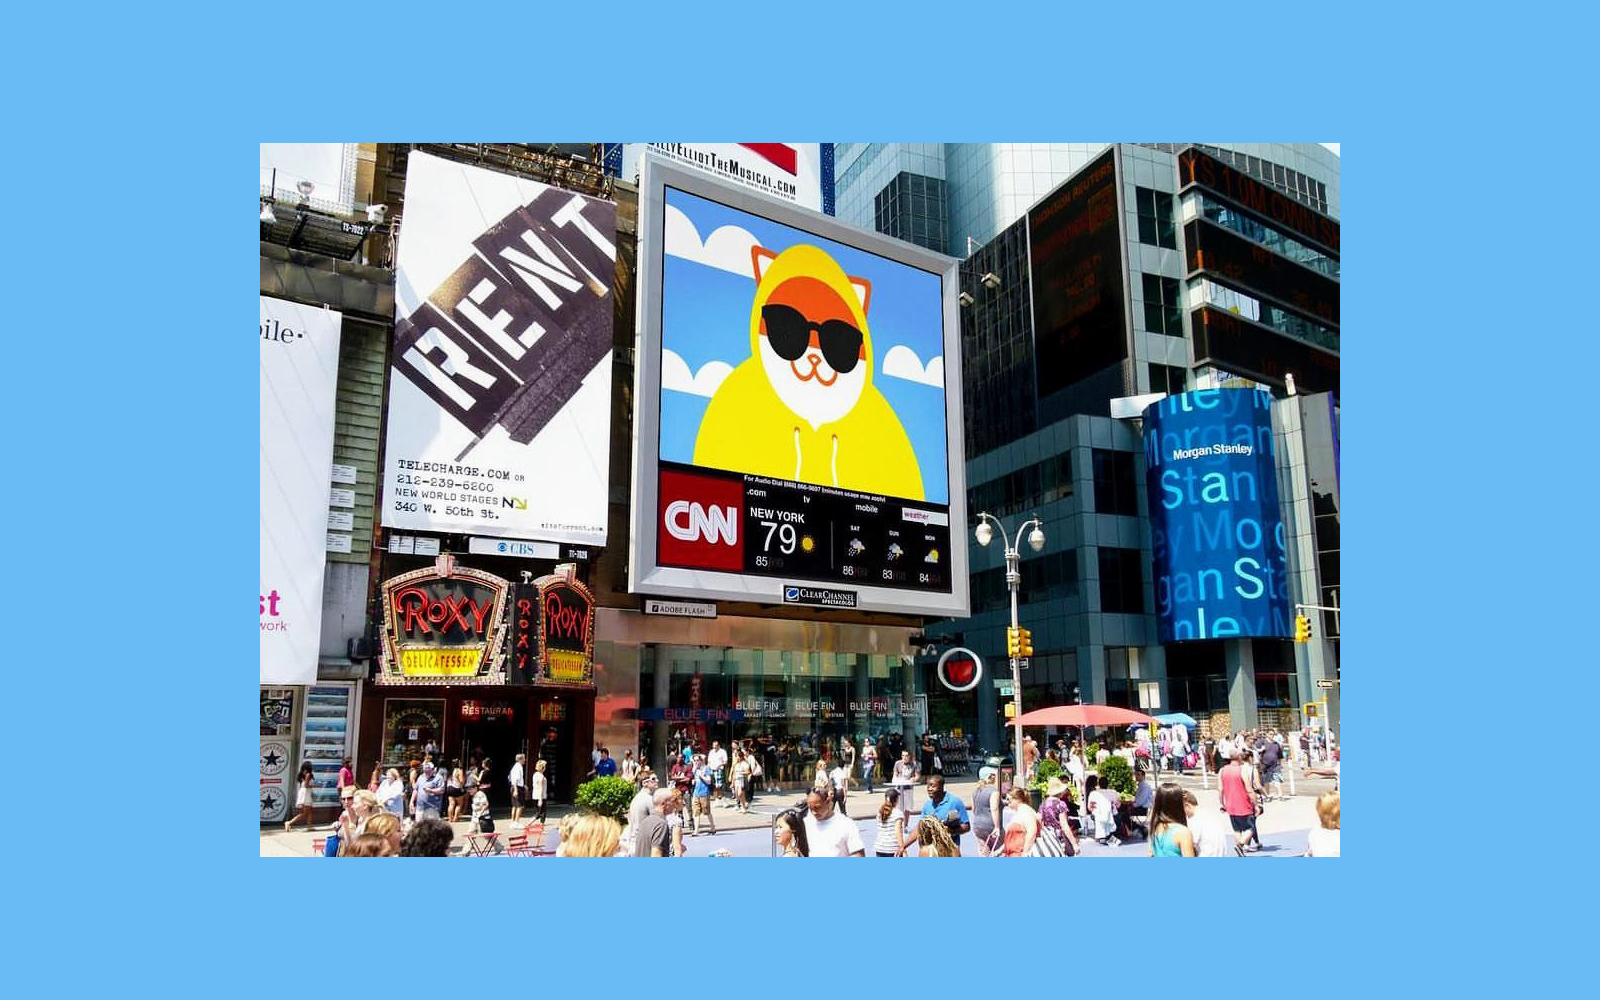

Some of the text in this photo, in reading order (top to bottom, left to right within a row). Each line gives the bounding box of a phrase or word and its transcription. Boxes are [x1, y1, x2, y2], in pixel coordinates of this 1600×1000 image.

[402, 195, 616, 411] RENT
[1173, 444, 1252, 460] Morgan Stanley
[398, 460, 510, 481] TELECHARGE.COM
[397, 474, 494, 492] 212-239-6200
[395, 488, 418, 498] NEW
[421, 491, 456, 501] WORLD
[460, 494, 498, 505] STAGES
[746, 488, 767, 497] .com
[855, 504, 878, 514] mobile
[904, 510, 929, 520] weather
[395, 501, 499, 520] 340 W. 50th St.
[750, 508, 805, 524] NEW YORK
[664, 500, 737, 546] CNN
[761, 521, 797, 554] 79
[511, 543, 534, 556] CBS
[756, 556, 768, 567] 85
[396, 588, 492, 634] ROXY
[546, 592, 588, 641] ROXY
[660, 606, 706, 615] ADOBE FLASH
[518, 600, 531, 669] ROXY
[406, 653, 475, 669] DELICATESSEN
[664, 708, 701, 720] BLUE
[707, 709, 731, 720] FIN
[736, 702, 780, 710] BLUE FIN
[796, 702, 835, 710] BLUE FIN
[850, 702, 887, 710] BLUE FIN
